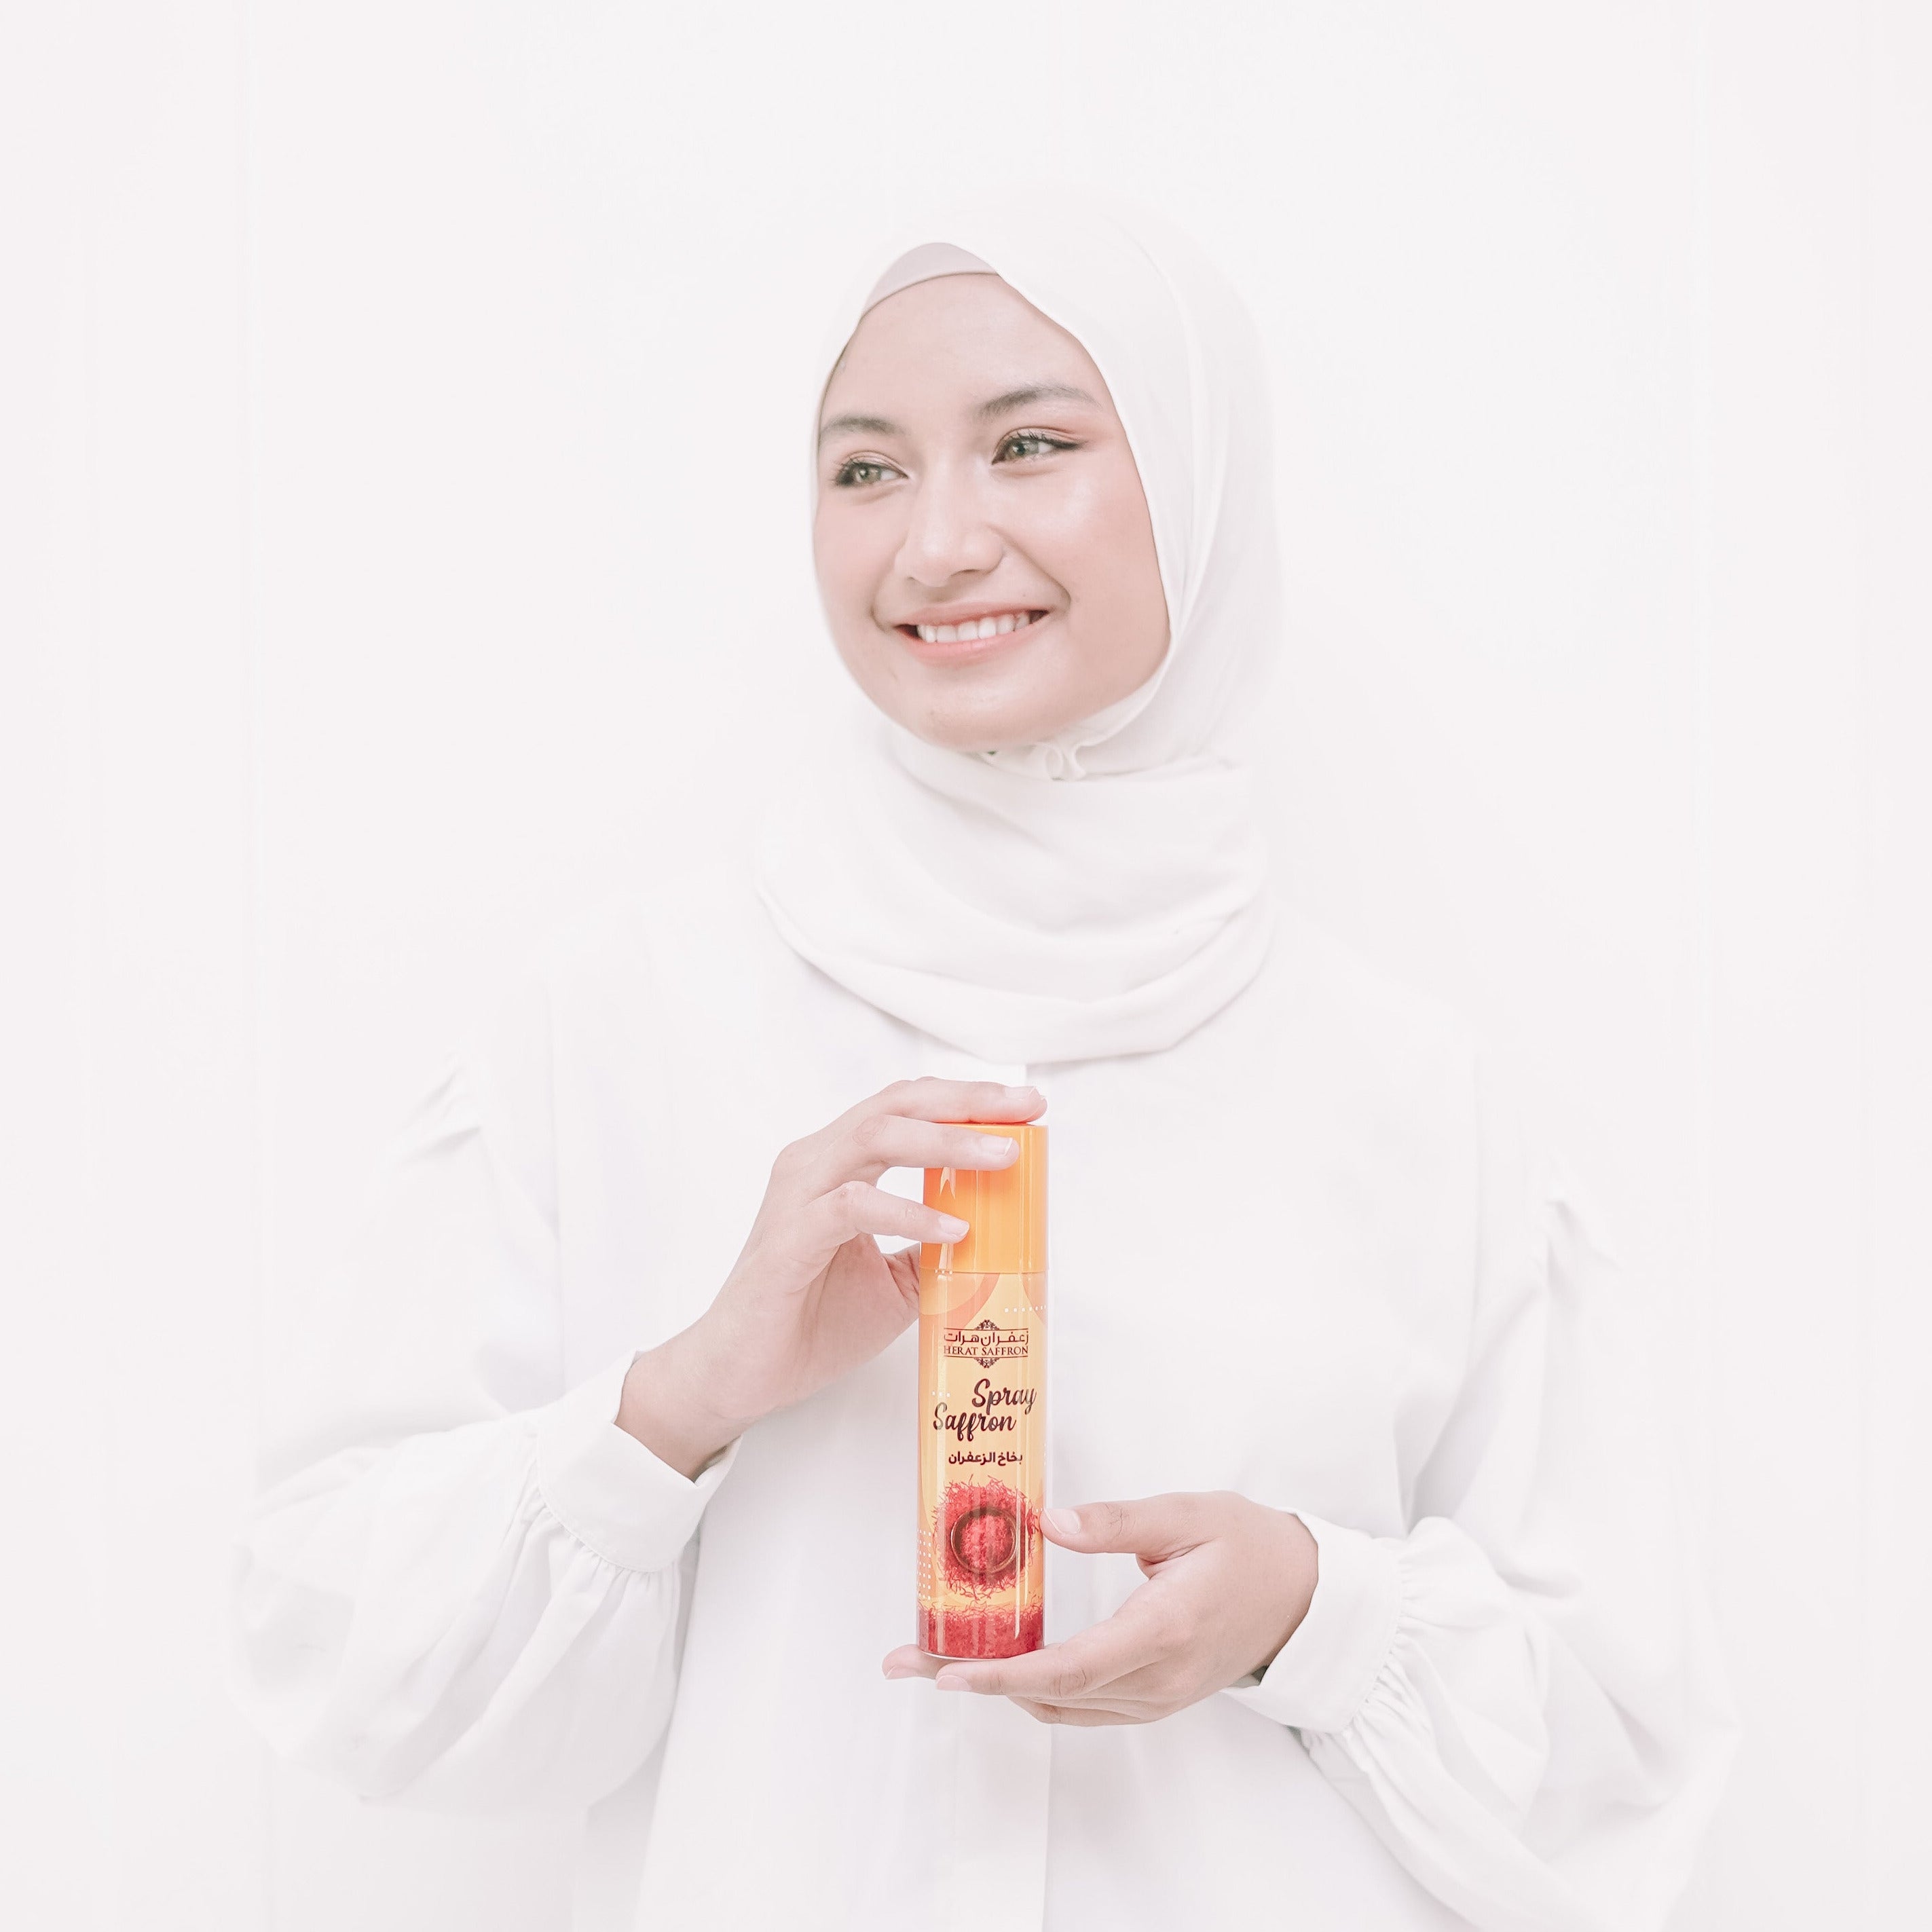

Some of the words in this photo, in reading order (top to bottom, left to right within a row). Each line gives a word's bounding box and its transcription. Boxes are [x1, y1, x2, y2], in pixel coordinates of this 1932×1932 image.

[944, 1331, 980, 1344] هرات
[981, 1331, 1028, 1346] زعفران
[944, 1345, 978, 1356] HERAT
[982, 1345, 1028, 1356] SAFFRON
[971, 1378, 1037, 1415] Spray
[933, 1402, 1017, 1442] Saffron
[948, 1451, 996, 1465] الزعفران
[997, 1451, 1023, 1466] بخاخ
